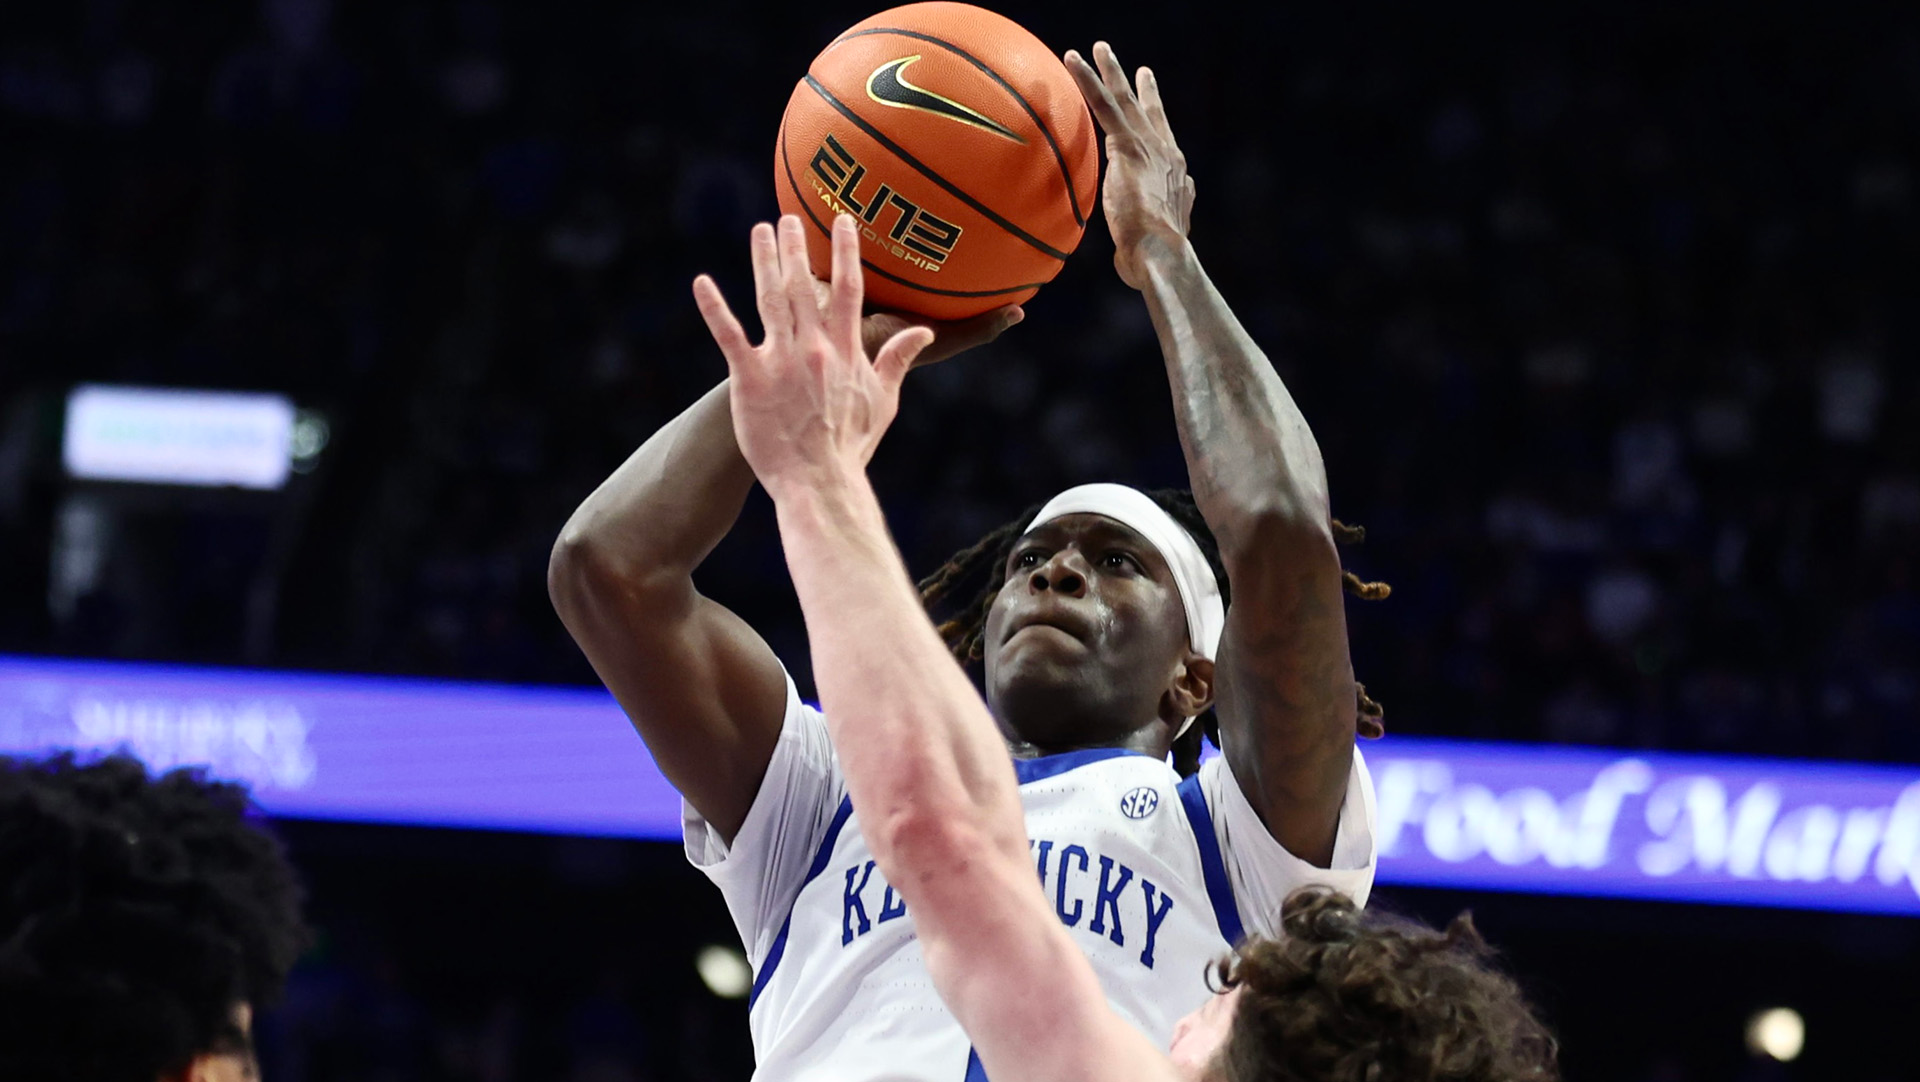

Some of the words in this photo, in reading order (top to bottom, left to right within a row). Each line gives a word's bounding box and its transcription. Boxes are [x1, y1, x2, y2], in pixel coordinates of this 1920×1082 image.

[803, 167, 941, 273] CHAMIONSHIP
[808, 132, 964, 265] ELITE
[1121, 787, 1158, 818] SEC
[1377, 758, 1655, 869] Food
[841, 839, 1174, 970] KECKY
